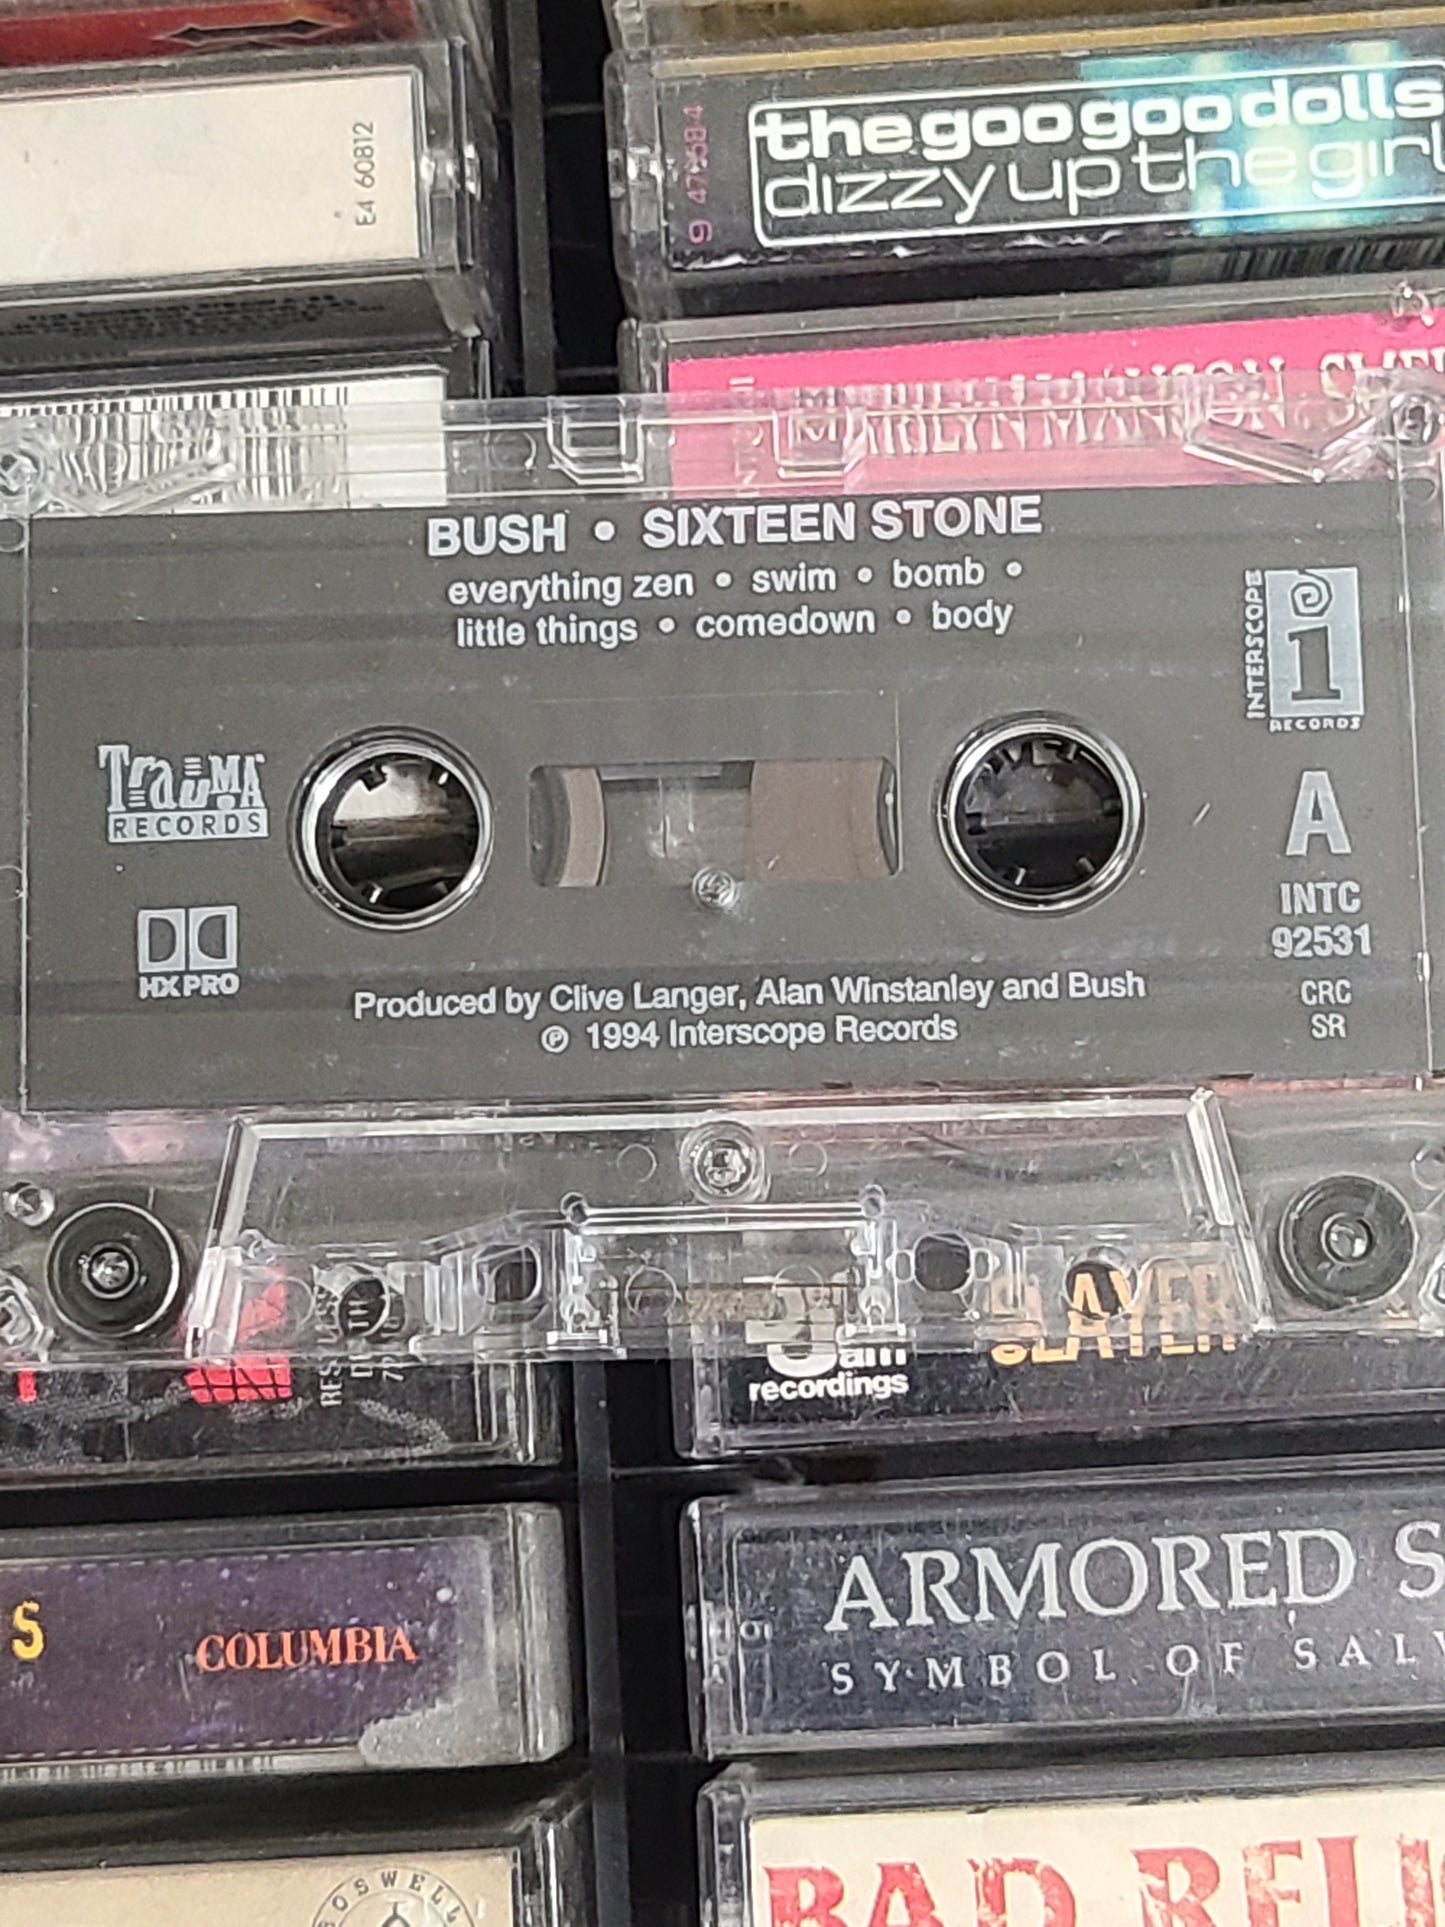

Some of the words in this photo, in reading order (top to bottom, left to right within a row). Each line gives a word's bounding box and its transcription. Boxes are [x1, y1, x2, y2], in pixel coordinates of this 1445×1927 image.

[353, 121, 376, 189] 60812
[764, 162, 996, 224] dizzy
[1008, 156, 1122, 217] up
[1131, 136, 1297, 194] the
[1309, 121, 1445, 200] girl
[357, 191, 377, 227] E4
[688, 220, 713, 244] 9
[427, 514, 566, 557] BUSH
[642, 503, 856, 549] SIXTEEN
[871, 496, 1042, 539] STONE
[449, 572, 622, 609] everything
[633, 574, 694, 599] zen
[751, 564, 837, 593] swim
[893, 557, 984, 589] bomb
[457, 616, 525, 648] little
[536, 613, 638, 649] things
[696, 605, 875, 638] comedown
[933, 601, 1013, 635] body
[1245, 569, 1267, 719] INTERSCOPE
[1269, 716, 1361, 732] RECORDS
[111, 812, 263, 840] RECORDS
[1286, 768, 1352, 856] A
[1280, 882, 1361, 915] INTC
[1271, 924, 1372, 958] 92531
[354, 989, 496, 1020] Produced
[505, 986, 542, 1020] by
[550, 983, 623, 1013] Clive
[634, 981, 747, 1015] Langer,
[755, 977, 822, 1008] Alan
[830, 974, 994, 1011] Winstanley
[1001, 972, 1059, 1000] and
[1069, 970, 1145, 999] Bush
[1301, 980, 1352, 1007] CRC
[586, 1022, 659, 1051] 1994
[669, 1017, 826, 1051] Interscope
[835, 1014, 958, 1045] Records
[1311, 1013, 1346, 1039] SR
[749, 1370, 909, 1402] recordings
[824, 1528, 1356, 1632] ARMORED
[197, 1624, 418, 1673] COLUMBIA
[831, 1649, 1116, 1695] SYMBOL
[1166, 1642, 1245, 1677] OF
